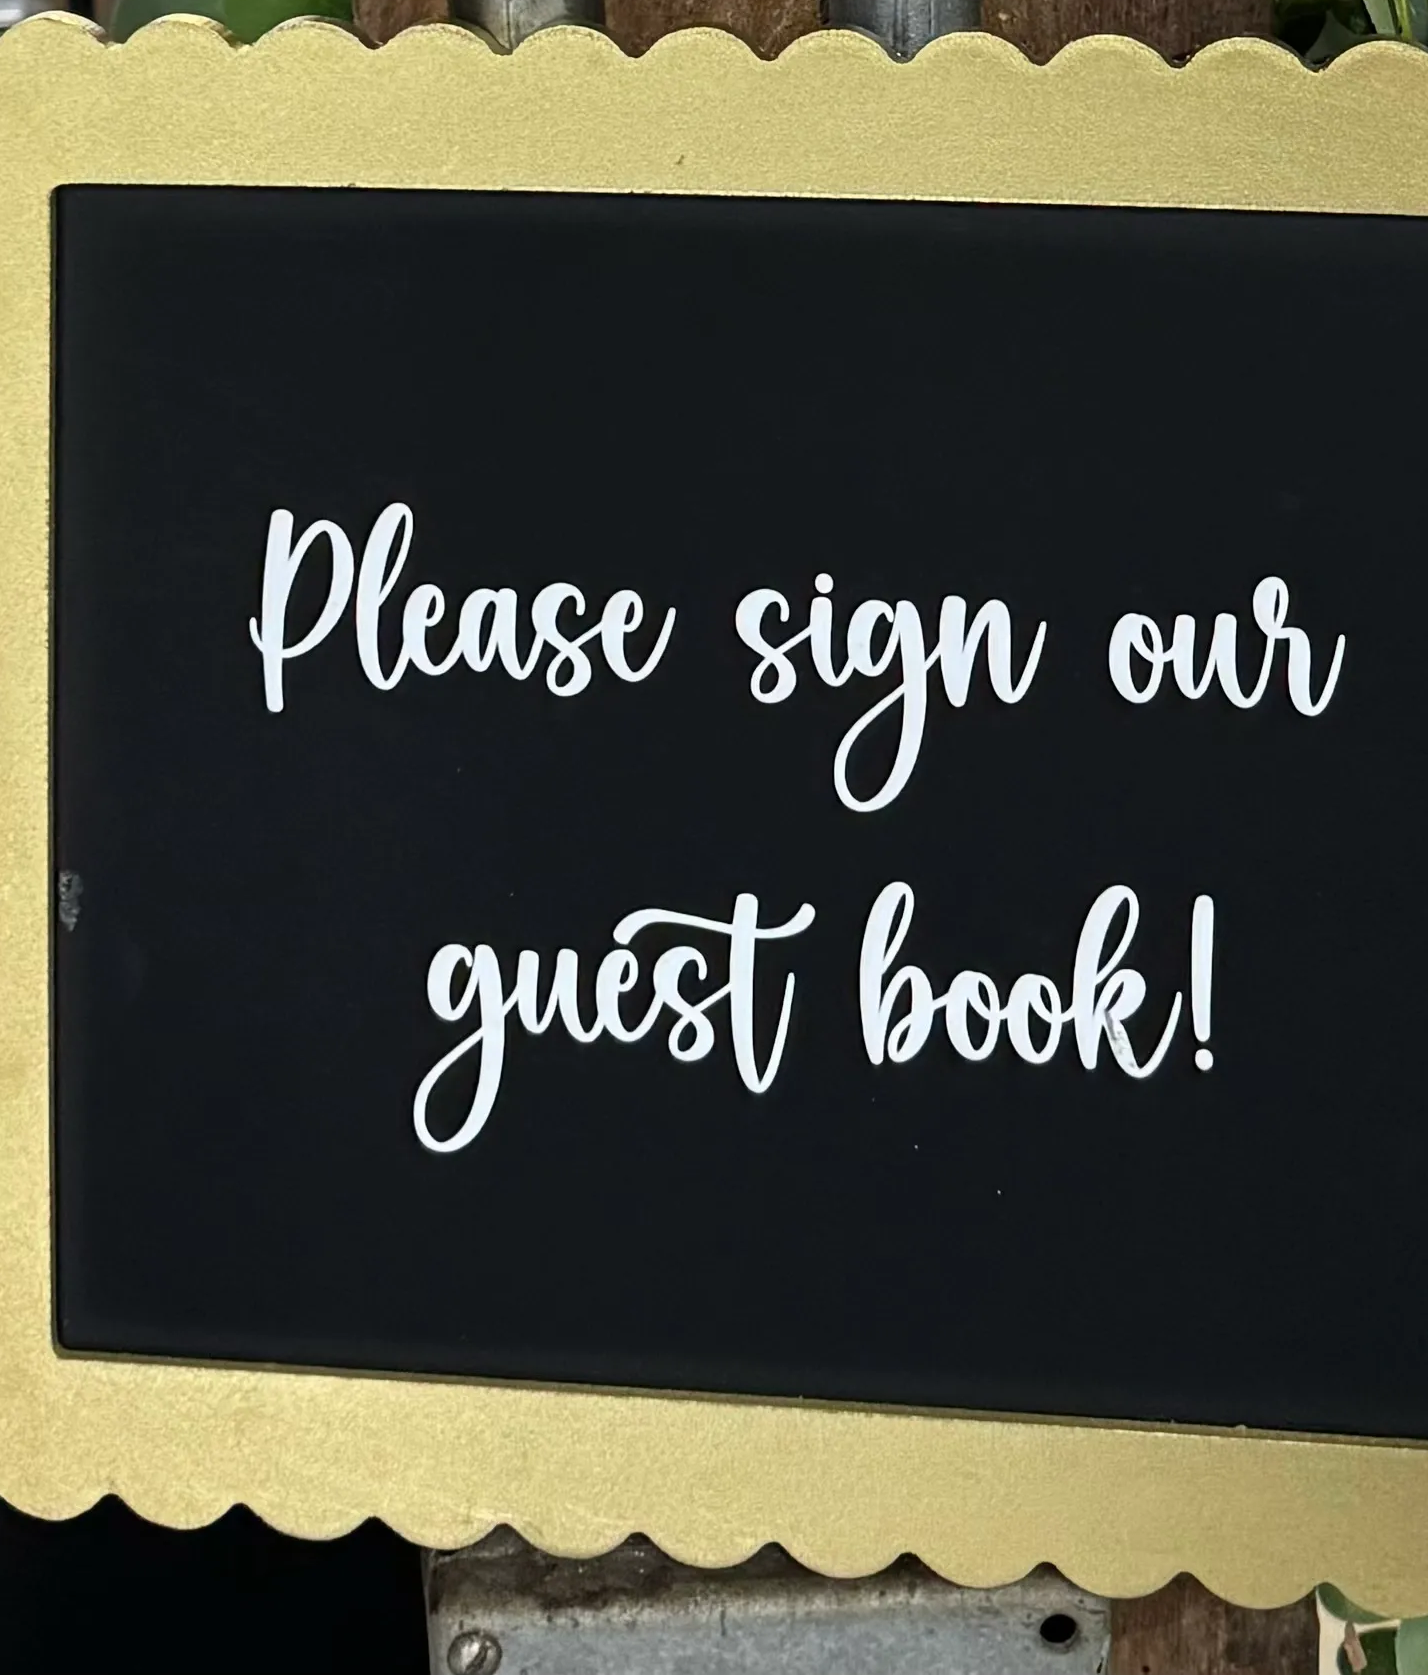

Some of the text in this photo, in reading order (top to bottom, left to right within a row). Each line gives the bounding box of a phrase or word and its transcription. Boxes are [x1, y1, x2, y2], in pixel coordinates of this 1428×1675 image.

[250, 503, 1345, 812] Please sign our
[414, 882, 1214, 1152] guest book!
